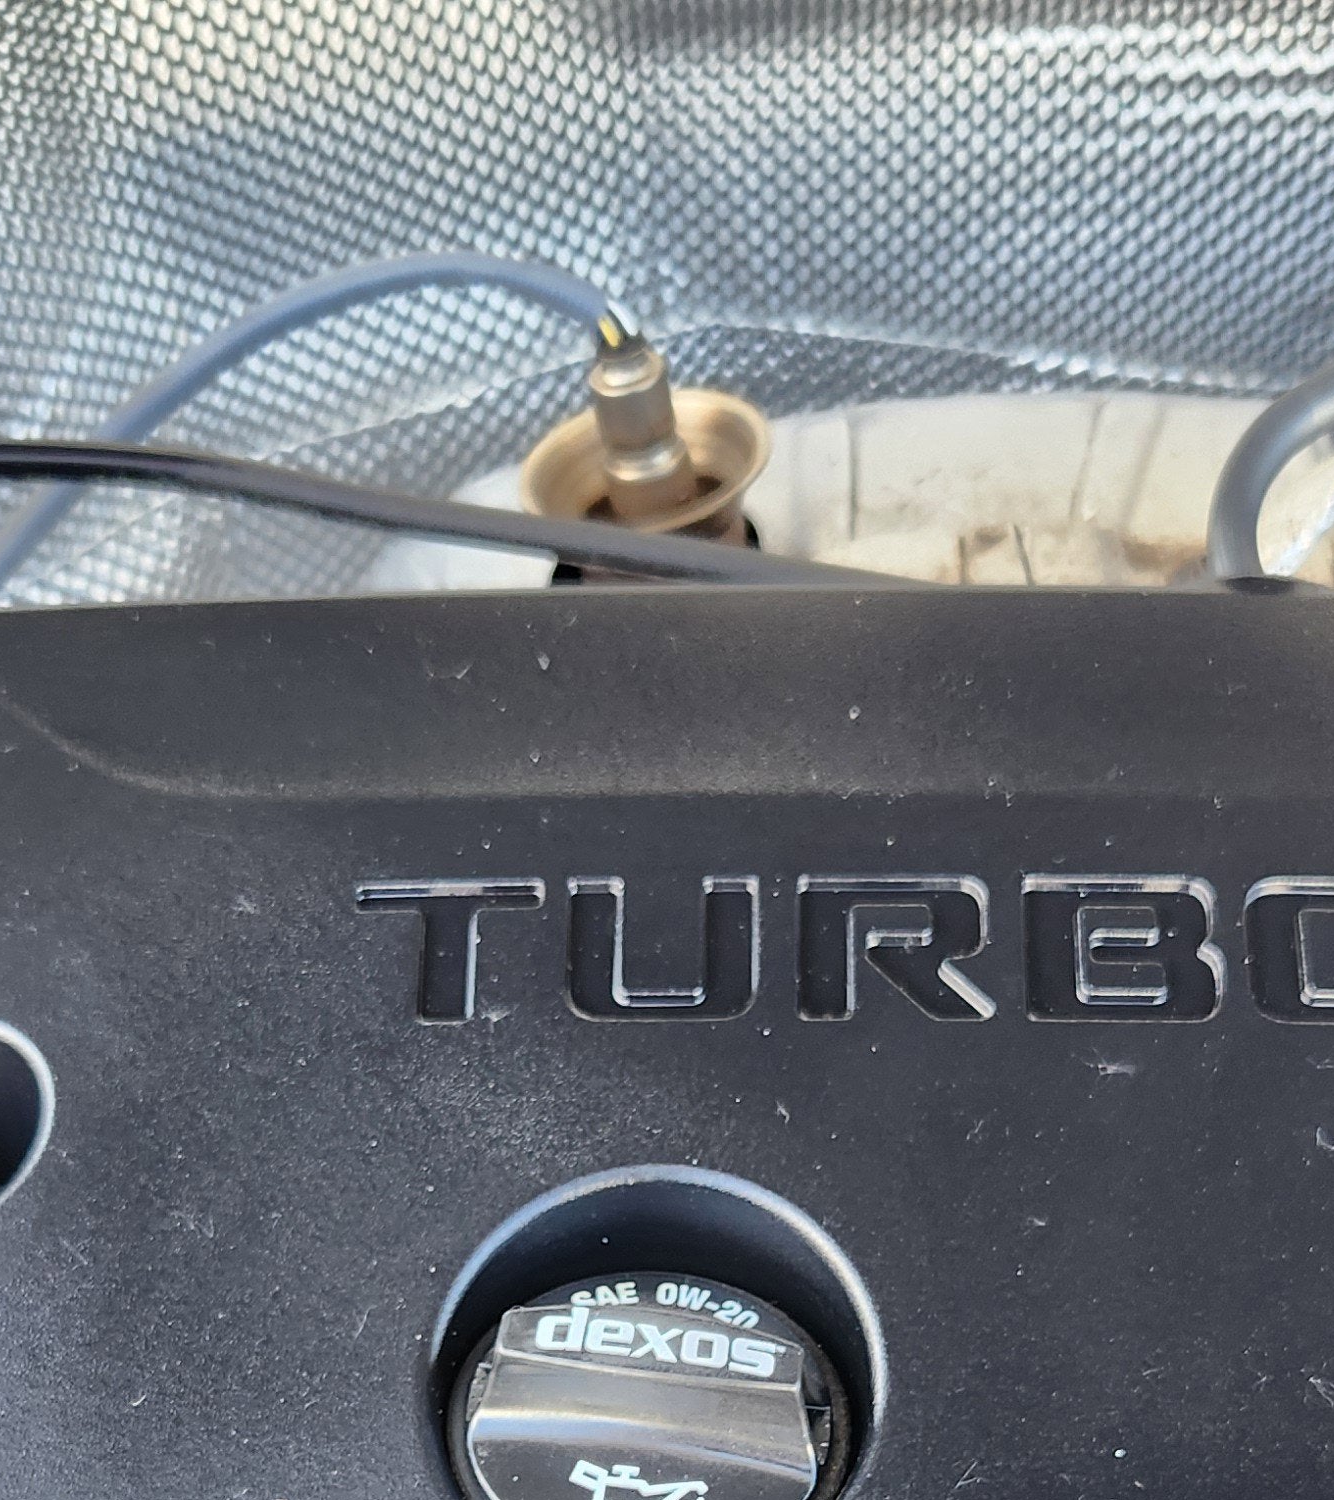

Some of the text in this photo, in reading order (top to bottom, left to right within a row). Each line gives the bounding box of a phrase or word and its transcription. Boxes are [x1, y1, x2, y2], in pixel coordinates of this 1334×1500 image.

[570, 1281, 760, 1329] SAE 0W-20
[535, 1306, 777, 1378] dexos
